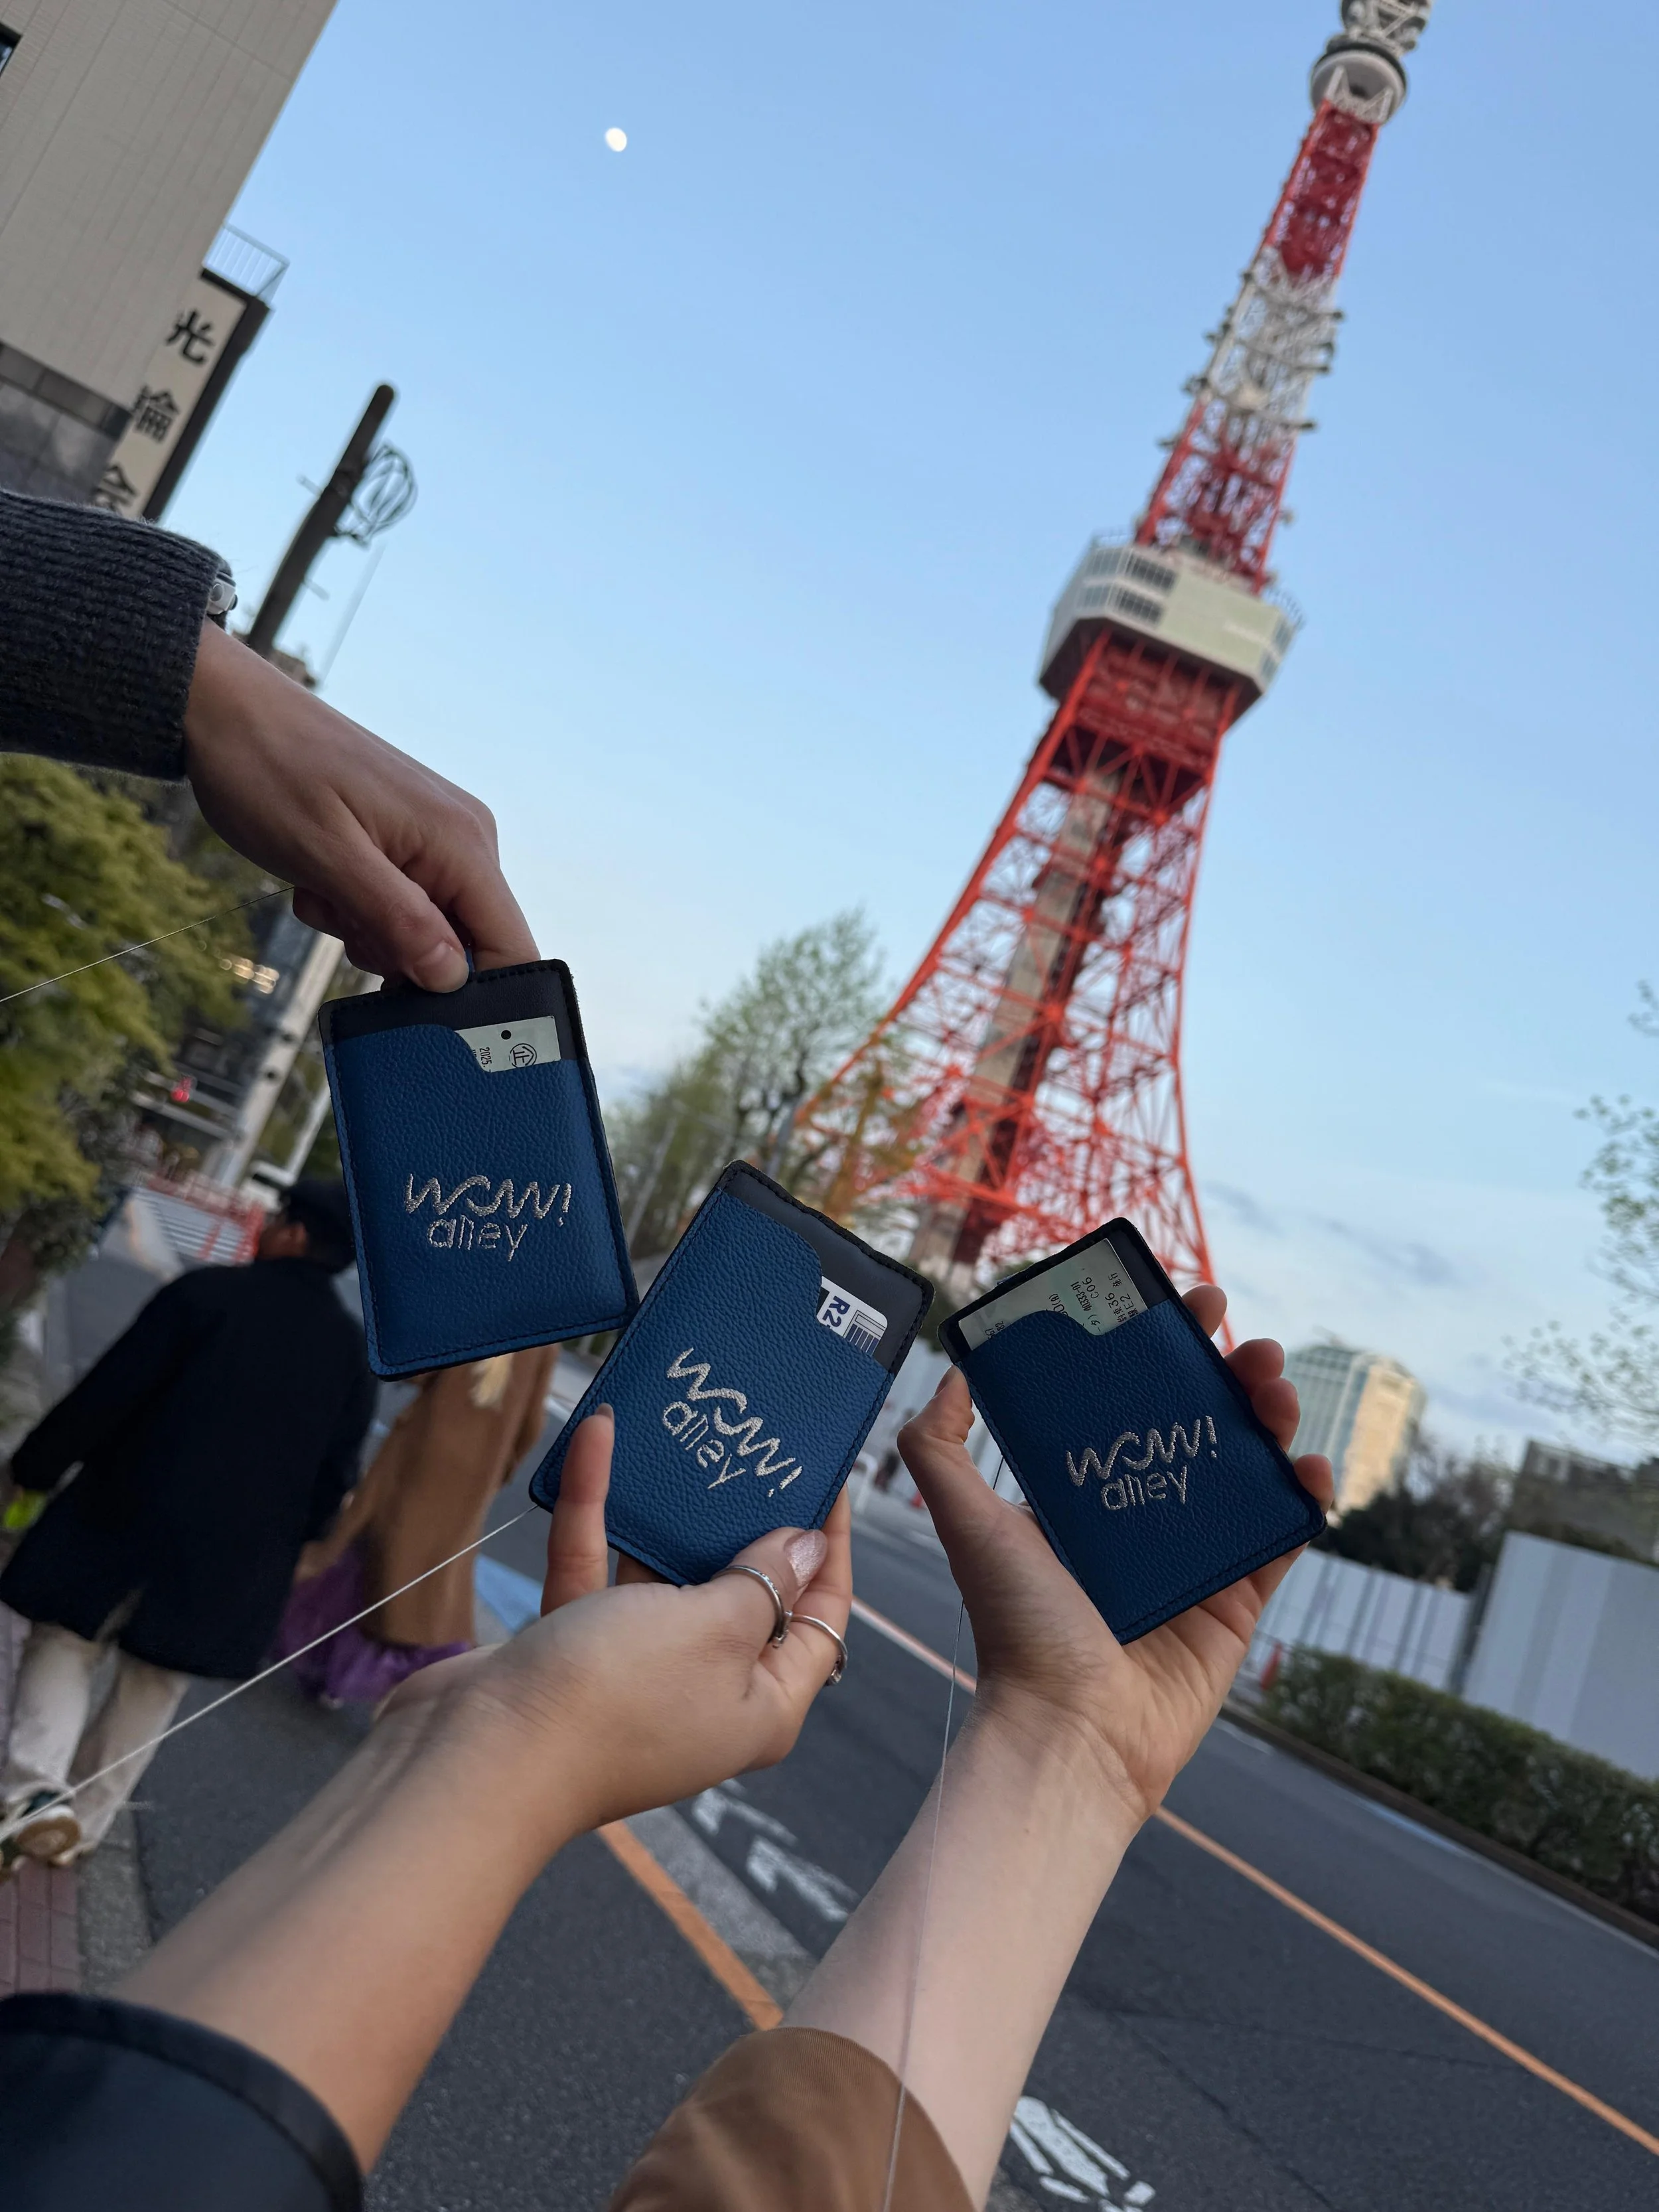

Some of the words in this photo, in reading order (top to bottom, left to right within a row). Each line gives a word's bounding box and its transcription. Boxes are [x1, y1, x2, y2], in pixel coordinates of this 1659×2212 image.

[479, 1047, 492, 1072] 2025.
[427, 1215, 528, 1262] alley
[1070, 1282, 1092, 1311] 40333-01
[1082, 1277, 1100, 1299] C06
[822, 1295, 851, 1328] R2
[1049, 1293, 1068, 1316] 0(A)
[662, 1401, 747, 1489] alley
[1100, 1465, 1188, 1511] alley
